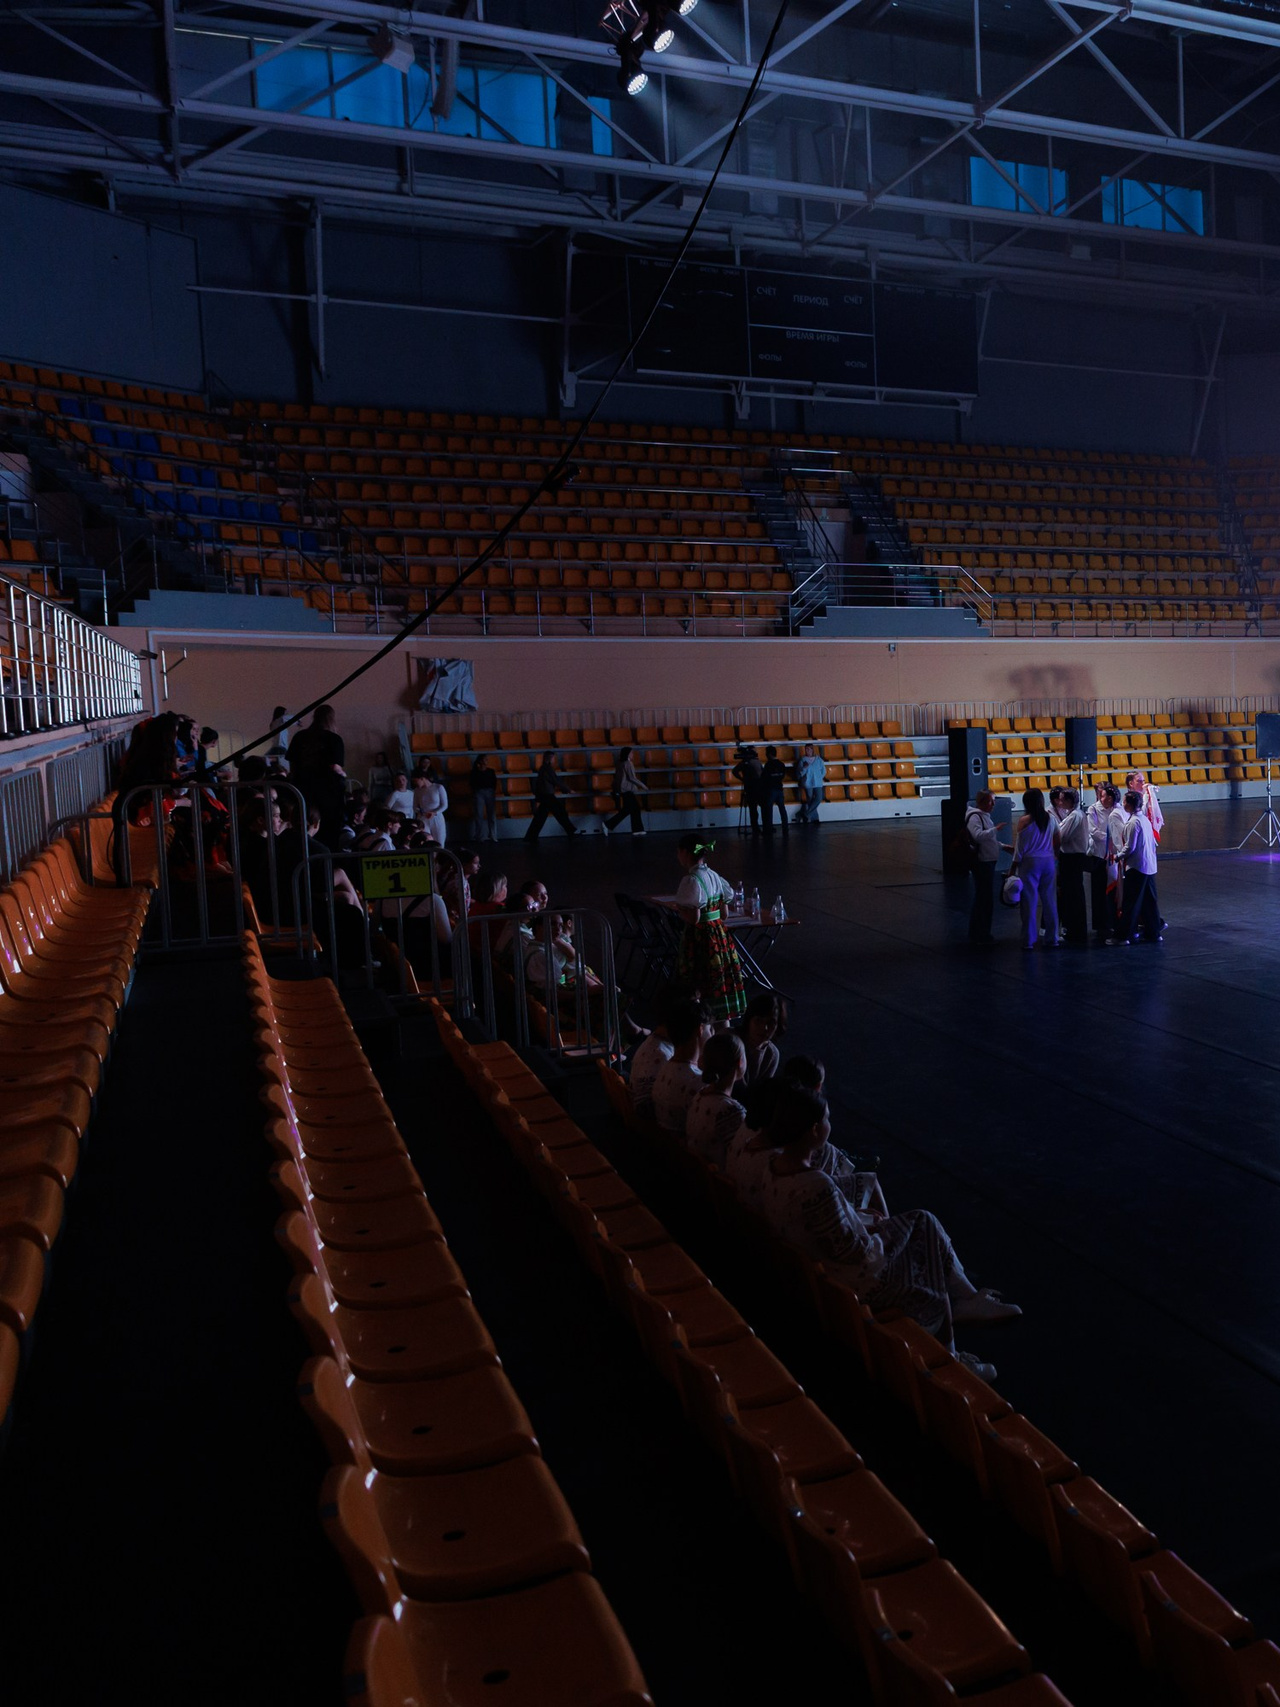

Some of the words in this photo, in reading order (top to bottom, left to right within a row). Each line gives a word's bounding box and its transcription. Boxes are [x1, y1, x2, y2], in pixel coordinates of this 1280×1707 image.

[793, 294, 829, 306] ПЕРИОД
[786, 331, 814, 341] ВРЕМЯ
[816, 333, 840, 343] ИГРЫ
[365, 858, 426, 870] ТРИБУНА
[388, 872, 406, 893] 1
